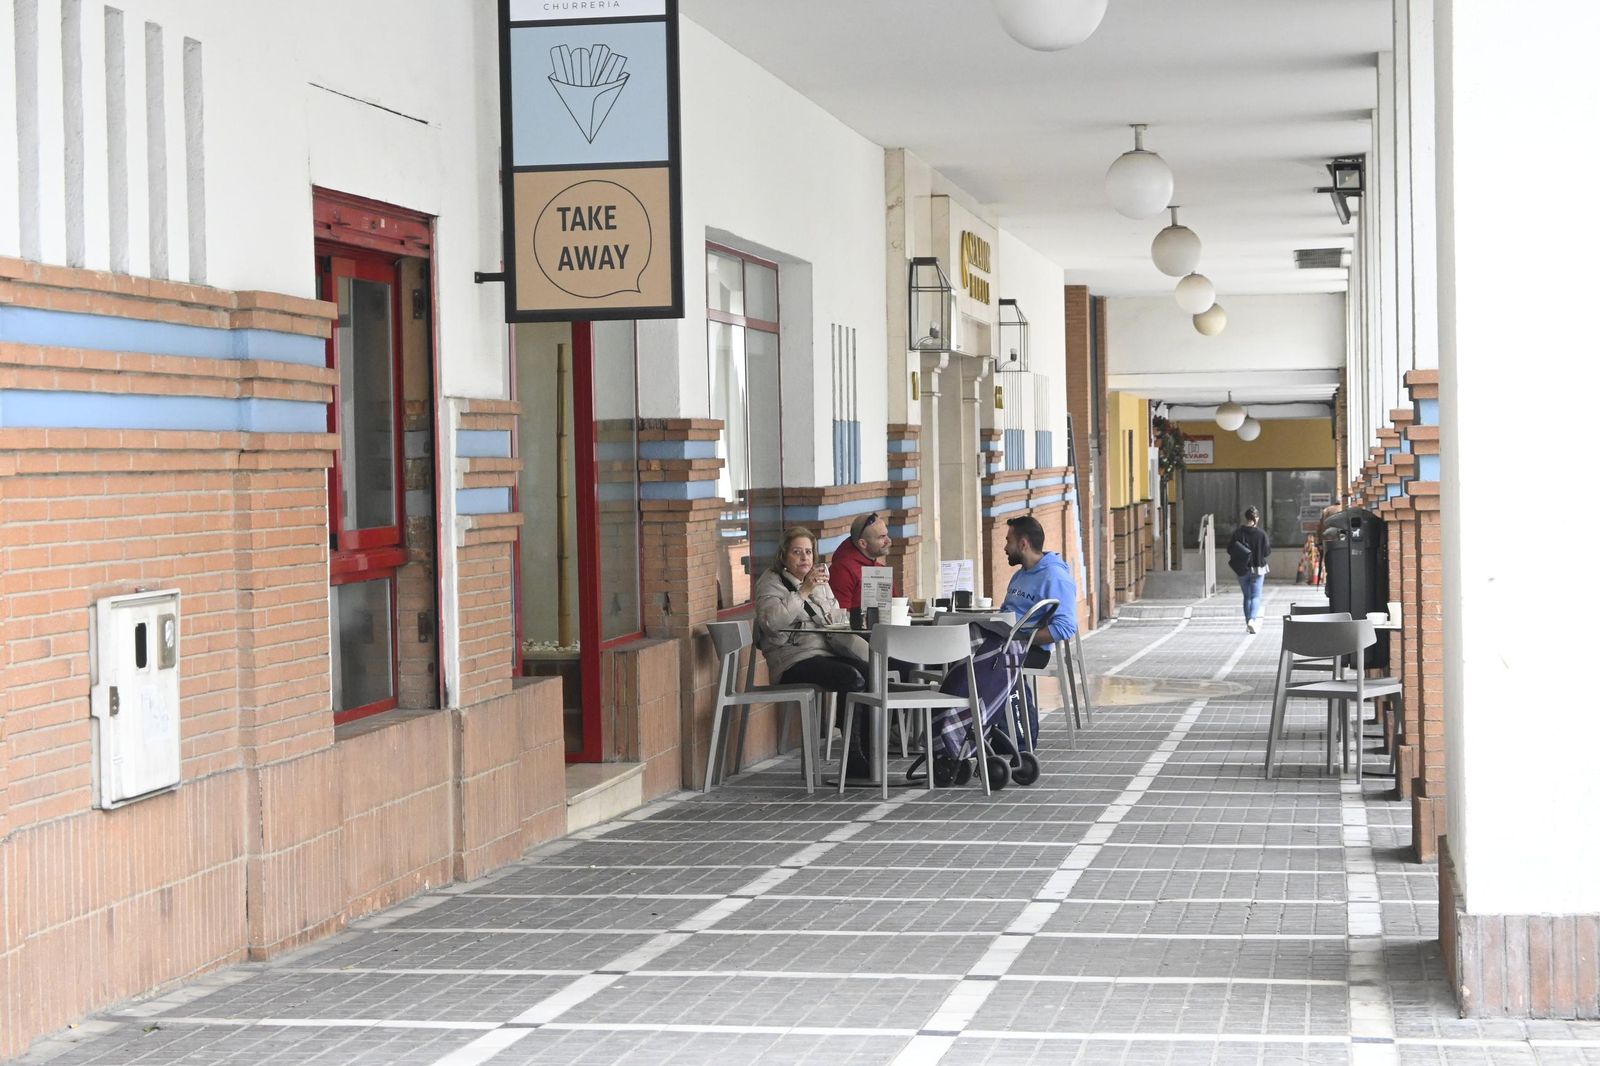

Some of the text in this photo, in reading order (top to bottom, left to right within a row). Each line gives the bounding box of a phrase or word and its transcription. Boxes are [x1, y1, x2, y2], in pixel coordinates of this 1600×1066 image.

[543, 0, 620, 11] CHURRERIA
[557, 205, 617, 232] TAKE
[557, 244, 630, 272] AWAY
